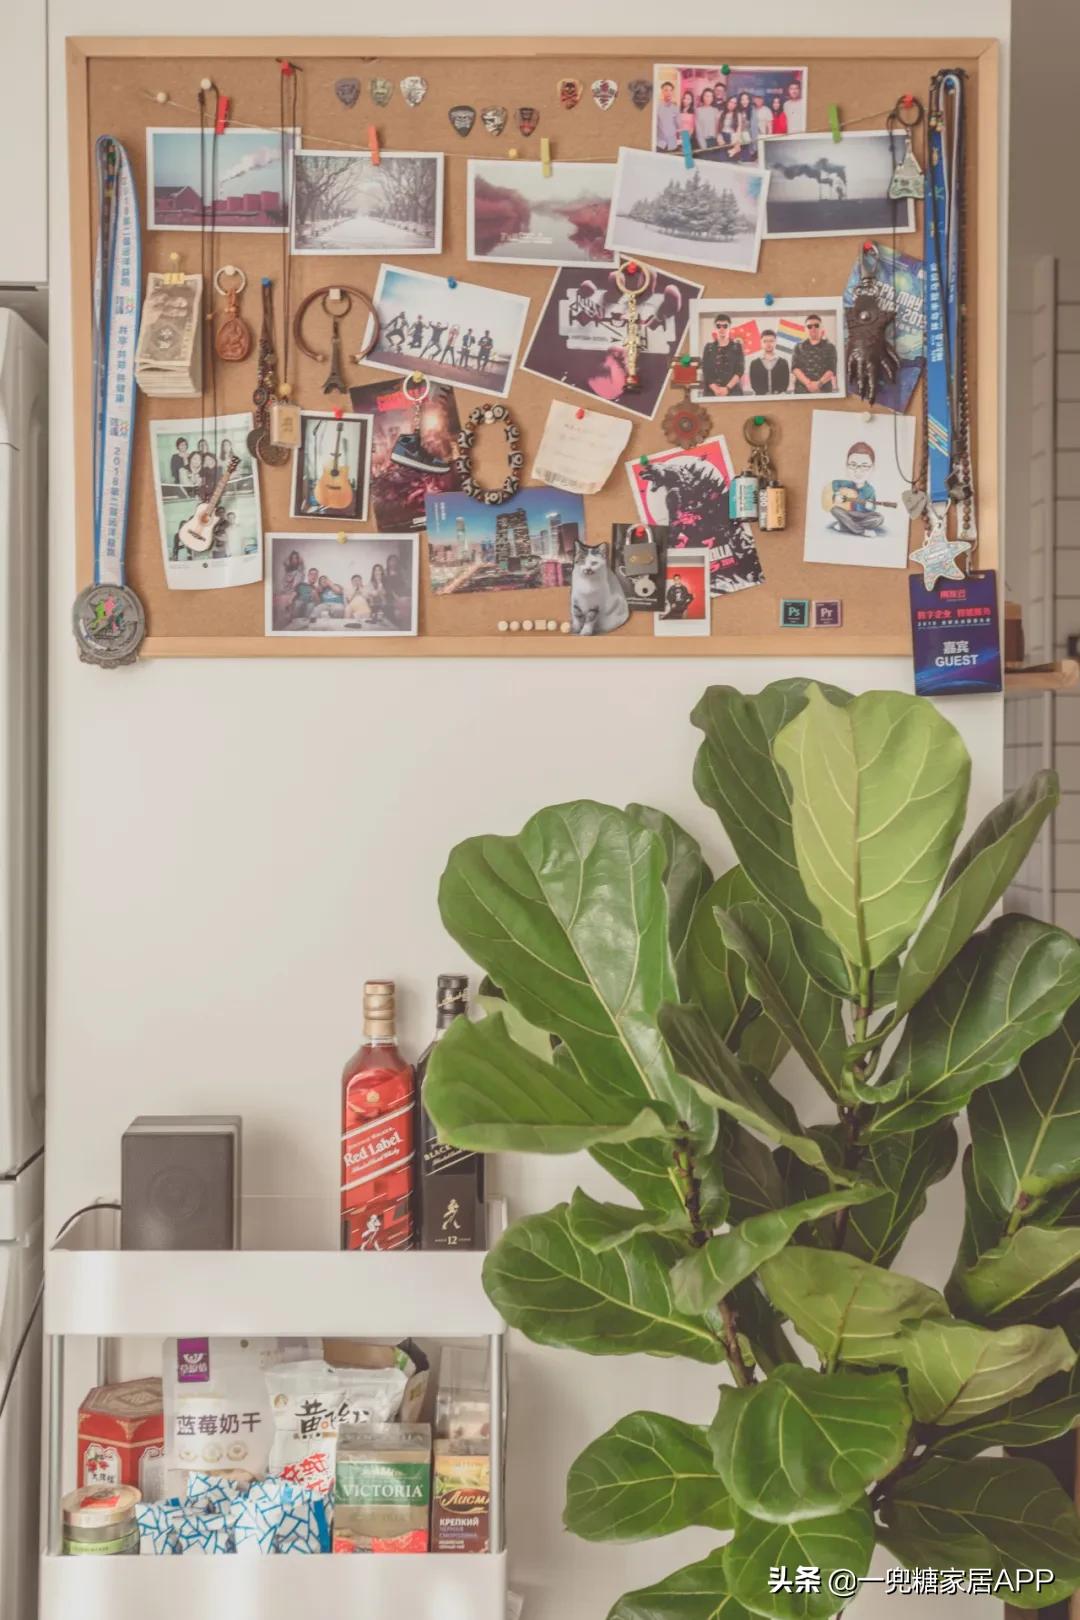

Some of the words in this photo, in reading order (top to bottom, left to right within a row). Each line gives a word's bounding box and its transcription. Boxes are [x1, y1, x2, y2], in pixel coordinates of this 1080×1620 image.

[788, 606, 801, 617] Ps
[820, 607, 833, 618] Pr
[943, 640, 969, 655] 嘉宾
[935, 655, 979, 667] GUEST
[343, 1145, 369, 1167] Red
[368, 1131, 402, 1156] Label
[447, 1235, 458, 1245] 12
[176, 1411, 262, 1436] 蓝莓奶干
[343, 1484, 423, 1498] VICTORIA
[441, 1490, 490, 1507] Лисм
[439, 1516, 480, 1527] КРЕПКИЙ
